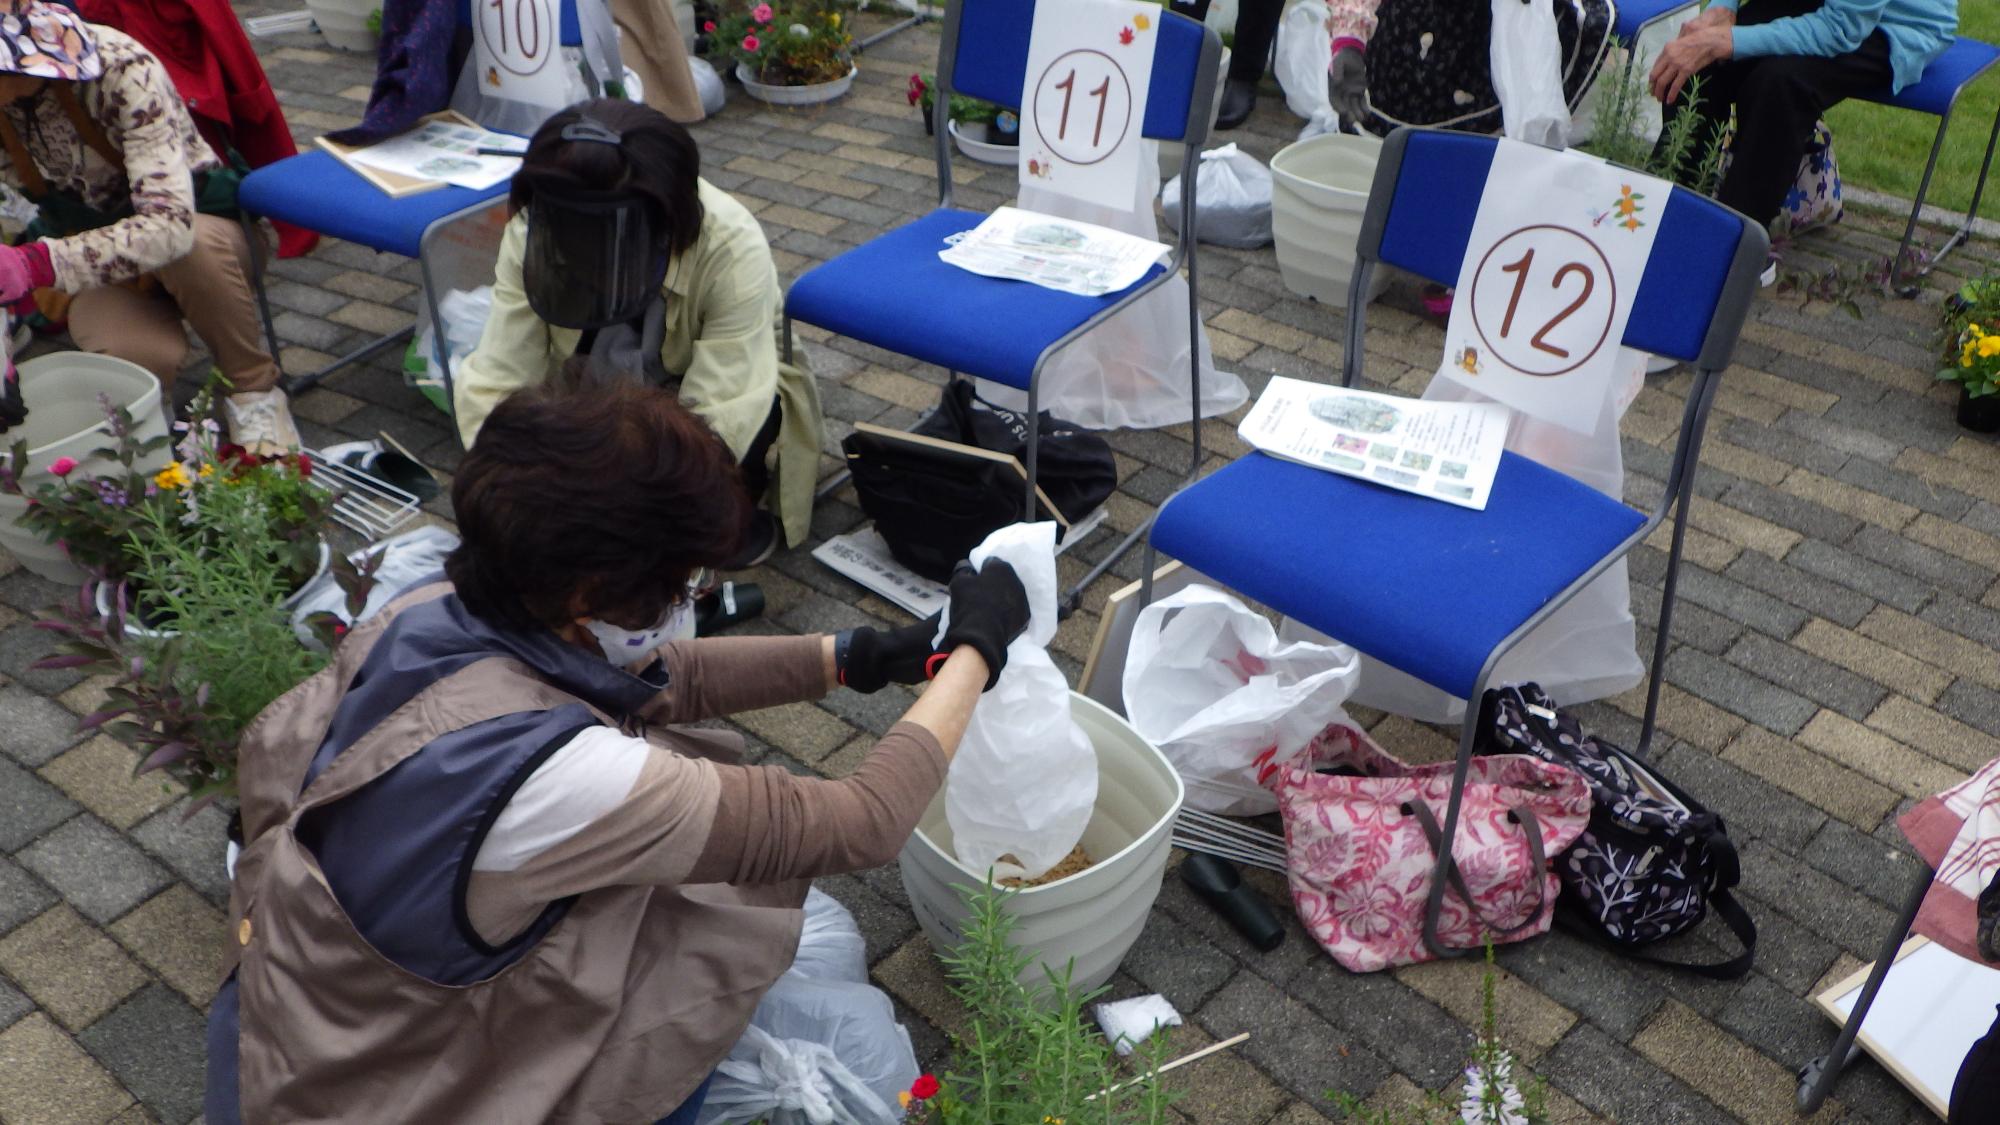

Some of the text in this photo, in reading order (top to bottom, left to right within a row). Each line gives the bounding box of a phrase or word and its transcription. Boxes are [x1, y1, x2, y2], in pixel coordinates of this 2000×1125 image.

[490, 0, 538, 58] 10
[1055, 68, 1110, 148] 11
[1502, 247, 1595, 359] 12
